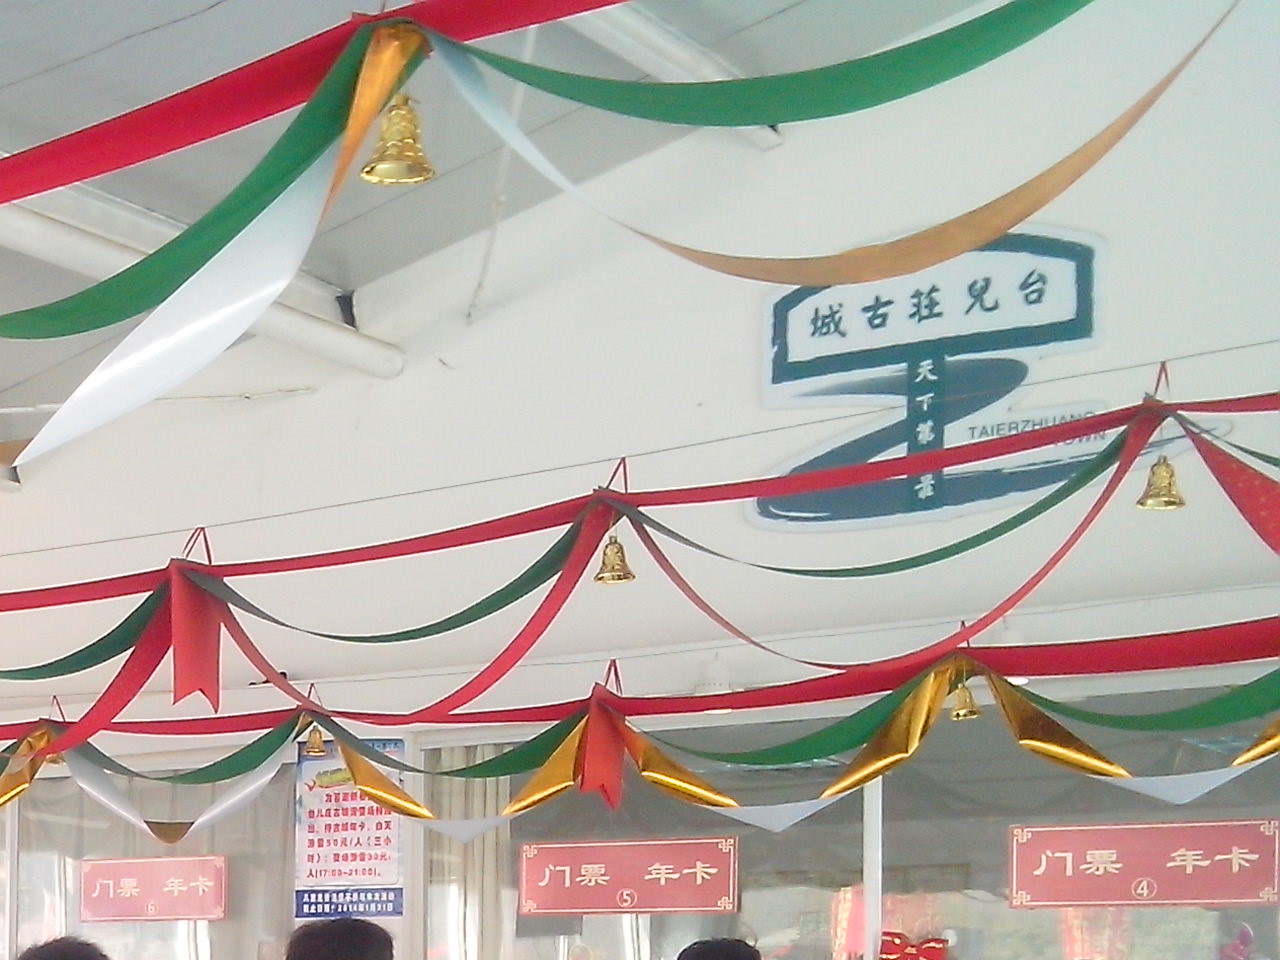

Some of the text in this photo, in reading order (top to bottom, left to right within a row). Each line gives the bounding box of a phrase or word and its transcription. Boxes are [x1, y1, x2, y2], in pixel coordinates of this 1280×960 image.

[538, 861, 718, 887] 门票 年卡
[1032, 846, 1260, 876] 门票 年卡
[91, 876, 214, 898] 门票 年卡
